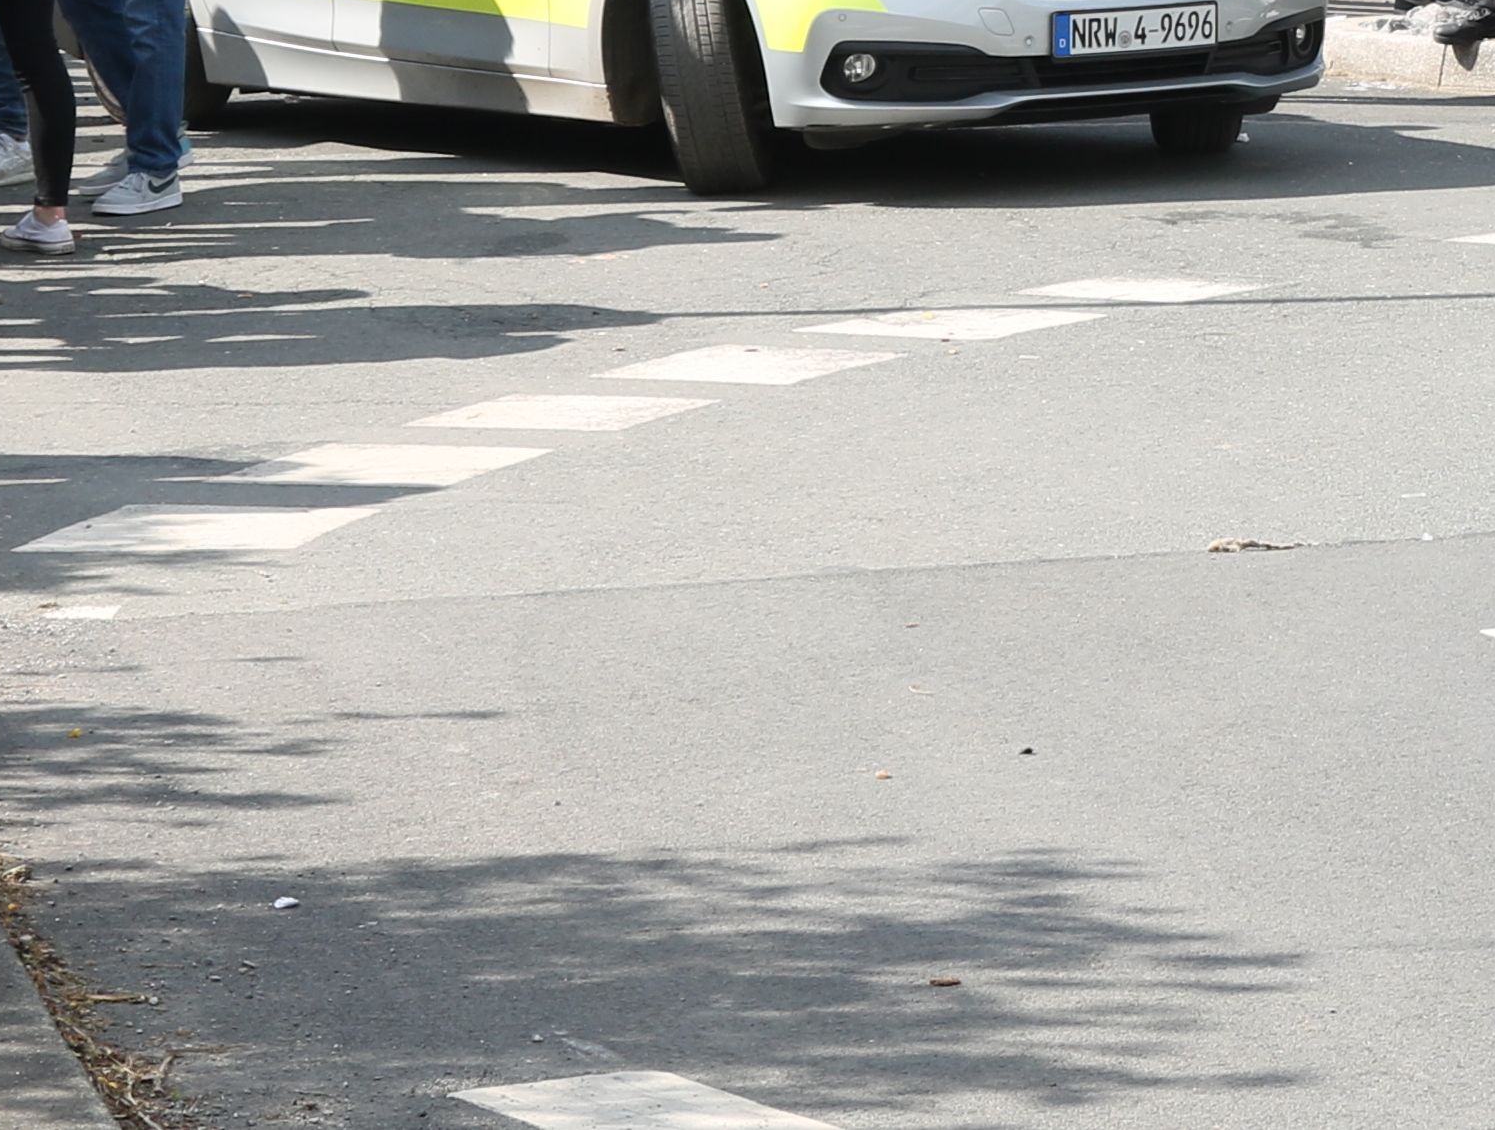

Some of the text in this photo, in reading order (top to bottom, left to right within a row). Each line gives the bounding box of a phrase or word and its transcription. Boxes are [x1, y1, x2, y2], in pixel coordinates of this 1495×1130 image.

[1059, 9, 1213, 49] D NRW 4-9696
